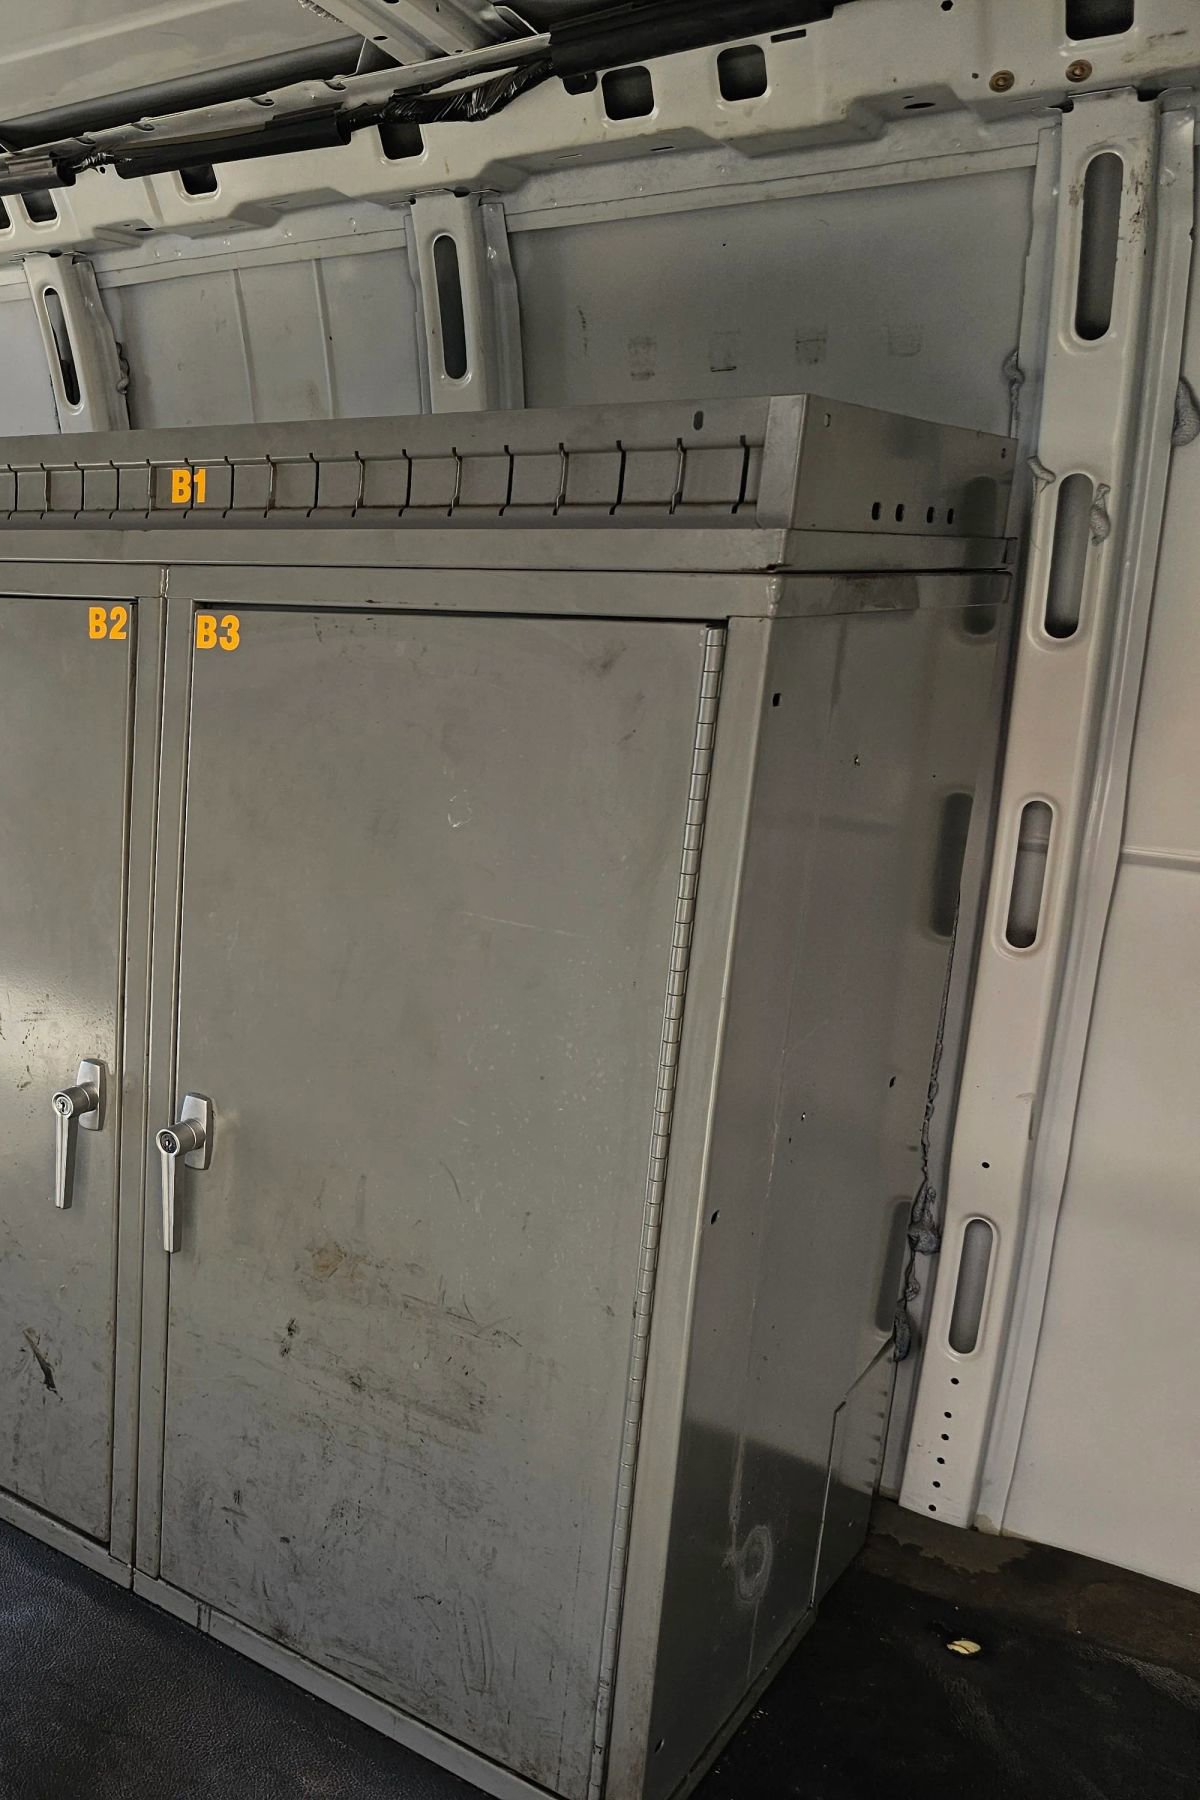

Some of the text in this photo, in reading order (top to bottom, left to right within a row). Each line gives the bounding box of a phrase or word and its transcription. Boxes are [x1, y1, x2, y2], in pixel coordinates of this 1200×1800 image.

[171, 468, 206, 504] B1
[88, 606, 128, 640] B2
[196, 614, 240, 651] B3
